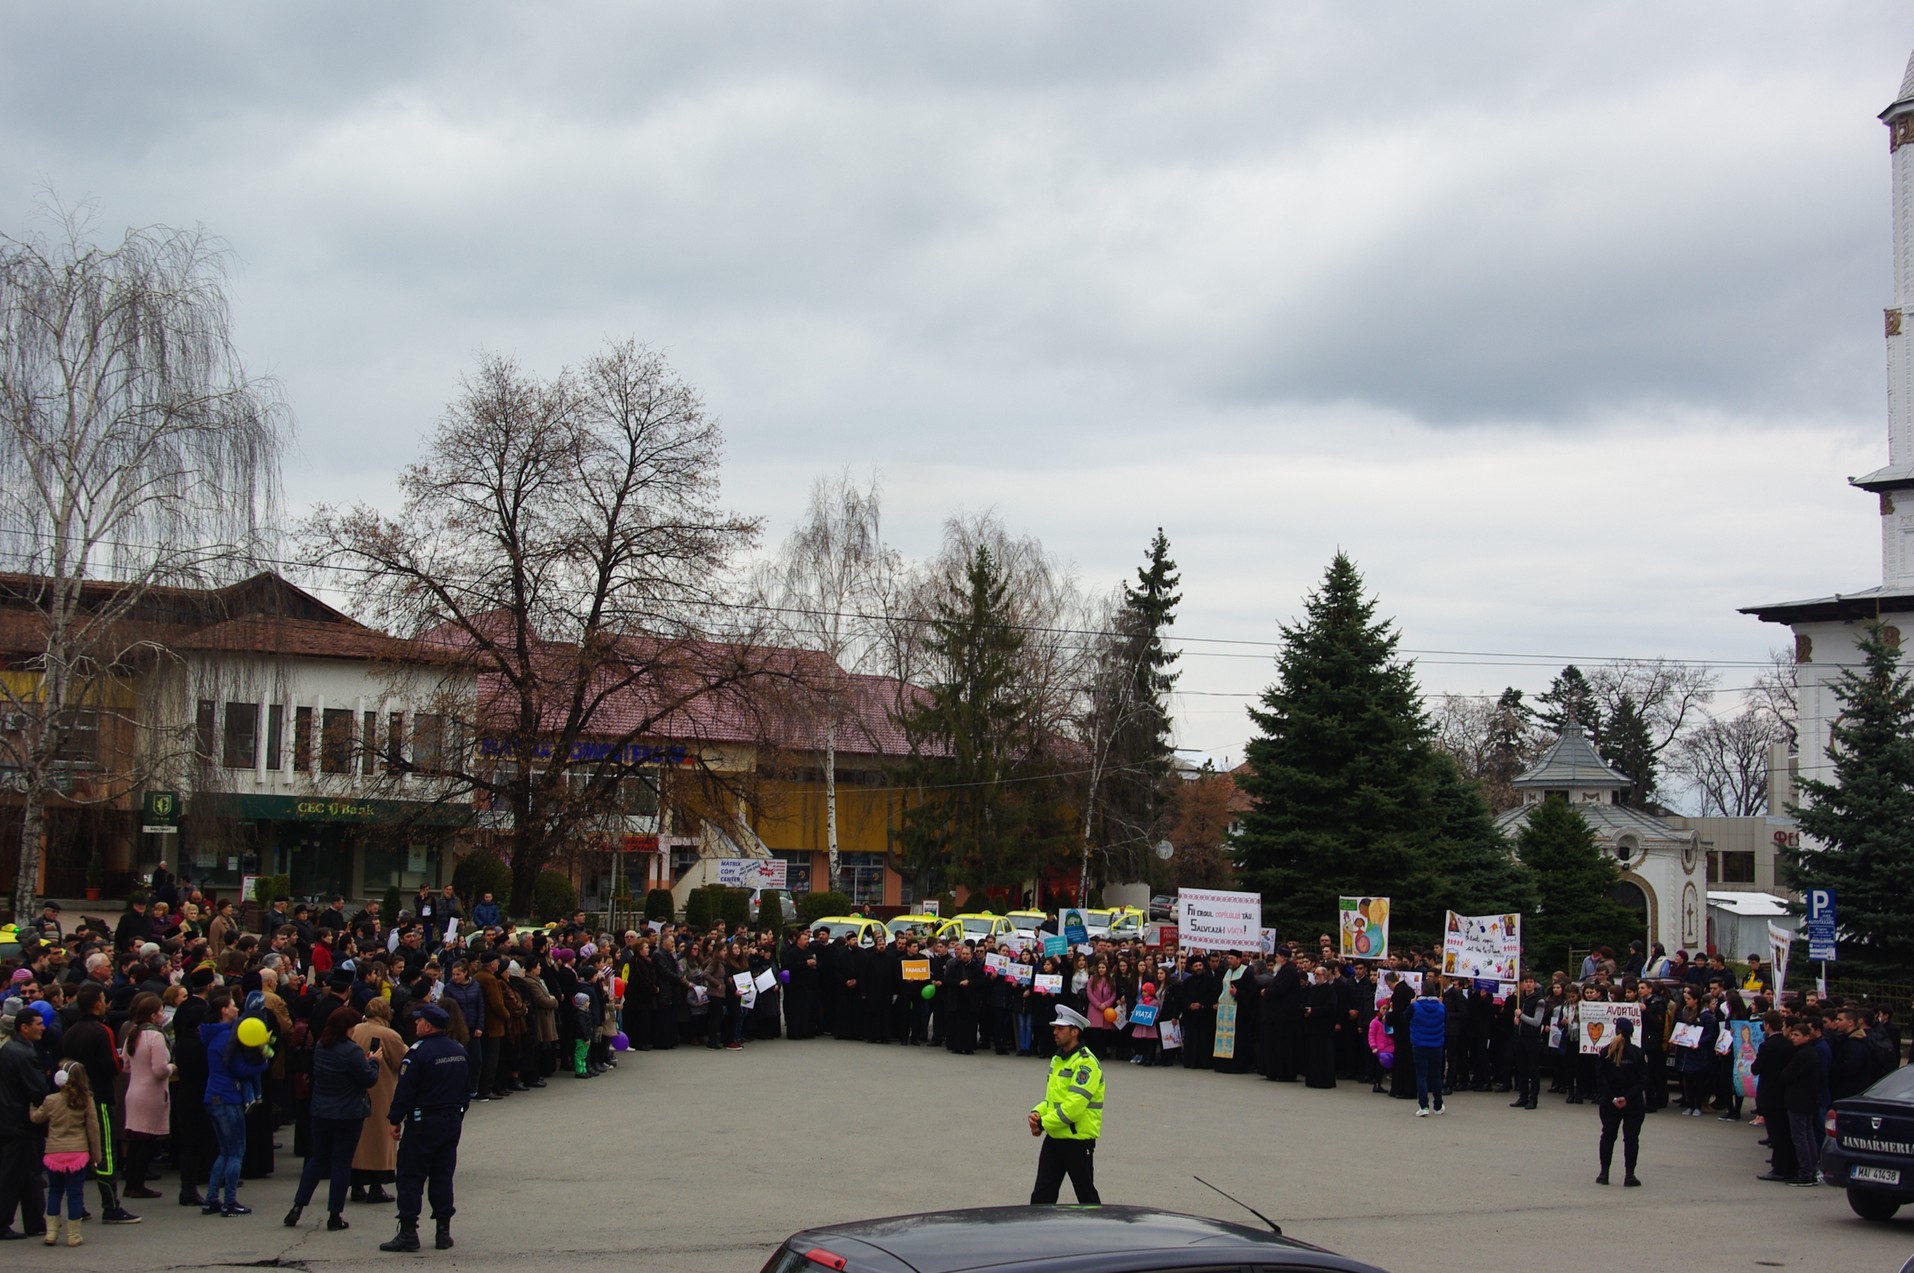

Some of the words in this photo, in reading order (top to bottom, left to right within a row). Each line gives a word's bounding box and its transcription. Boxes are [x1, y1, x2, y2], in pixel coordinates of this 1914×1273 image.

[297, 802, 325, 814] CEC
[341, 804, 374, 816] Bank
[1813, 890, 1829, 919] P
[1135, 1009, 1153, 1020] VIAȚĂ
[1606, 1005, 1641, 1017] AVORTUL
[1858, 1167, 1871, 1178] MAI
[1873, 1169, 1897, 1182] 41438
